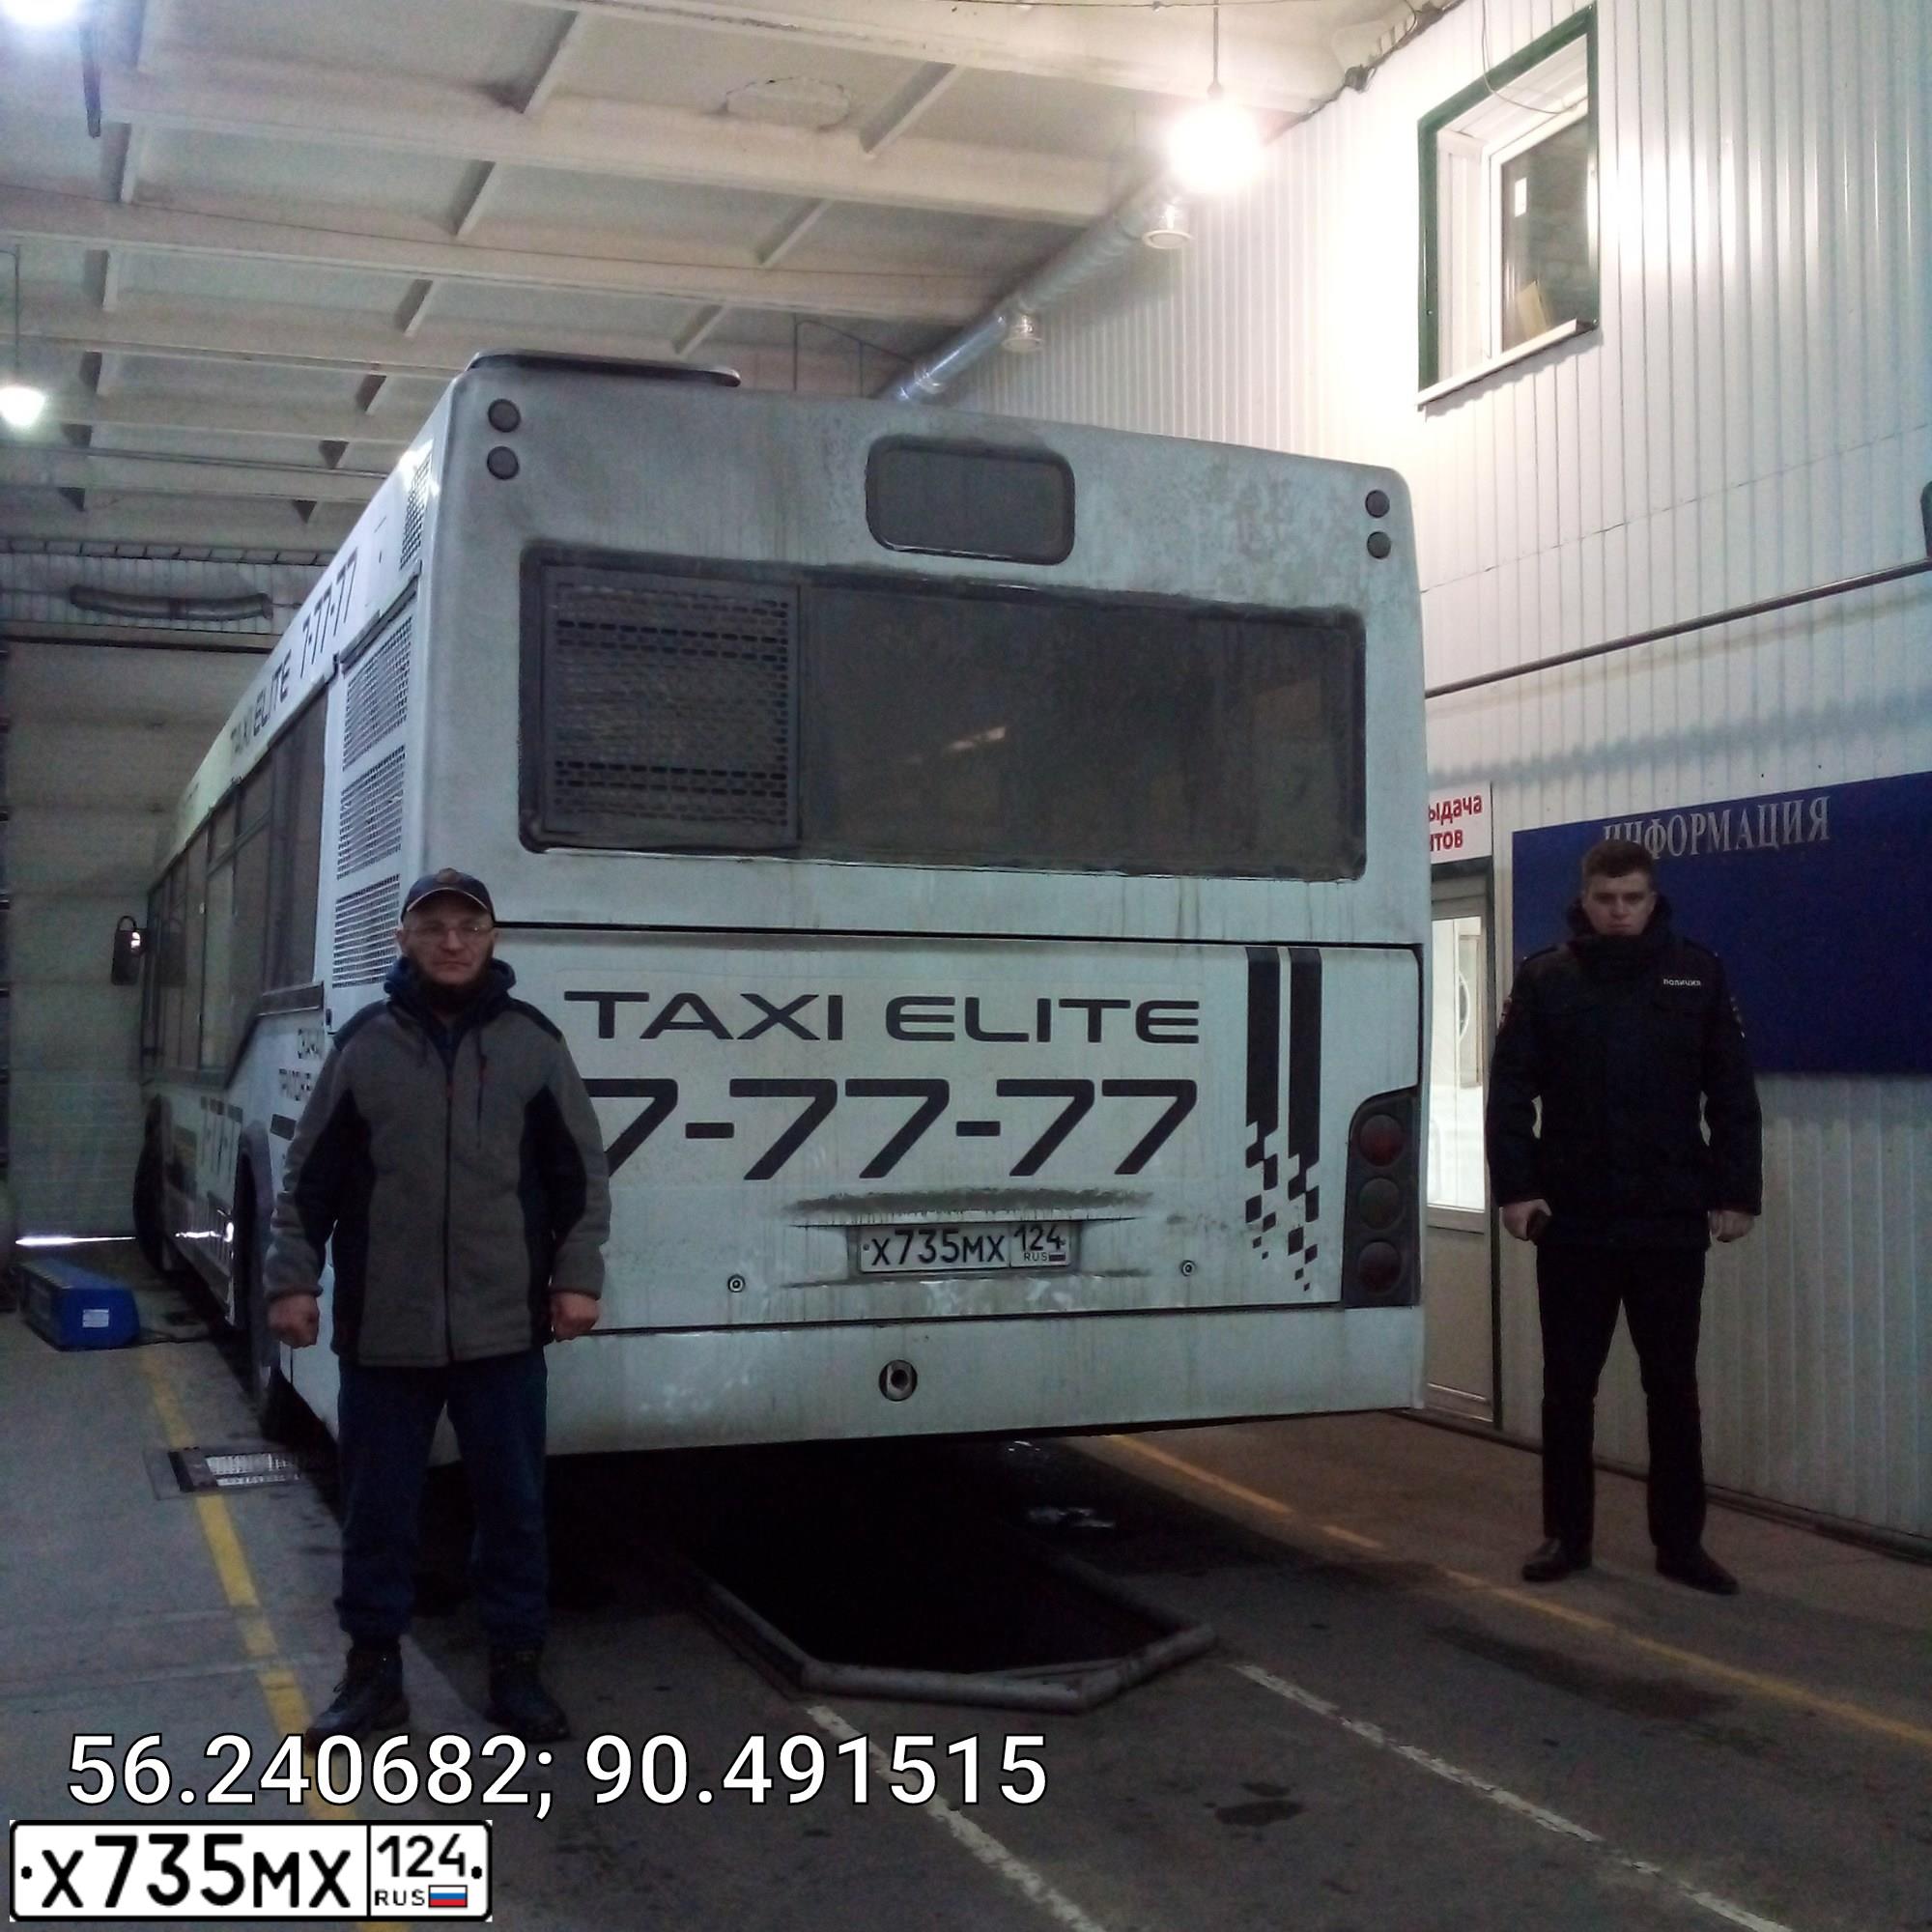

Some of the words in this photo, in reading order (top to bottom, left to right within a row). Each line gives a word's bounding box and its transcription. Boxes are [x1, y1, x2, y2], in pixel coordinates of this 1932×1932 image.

[254, 649, 292, 737] ELITE
[300, 547, 358, 679] 7-77-77
[1429, 795, 1483, 825] ыдача
[564, 990, 843, 1040] TAXI
[886, 996, 1200, 1044] ELITE
[582, 1078, 1198, 1180] 7-77-77
[1014, 1223, 1062, 1252] 124
[1023, 1251, 1048, 1263] RUS
